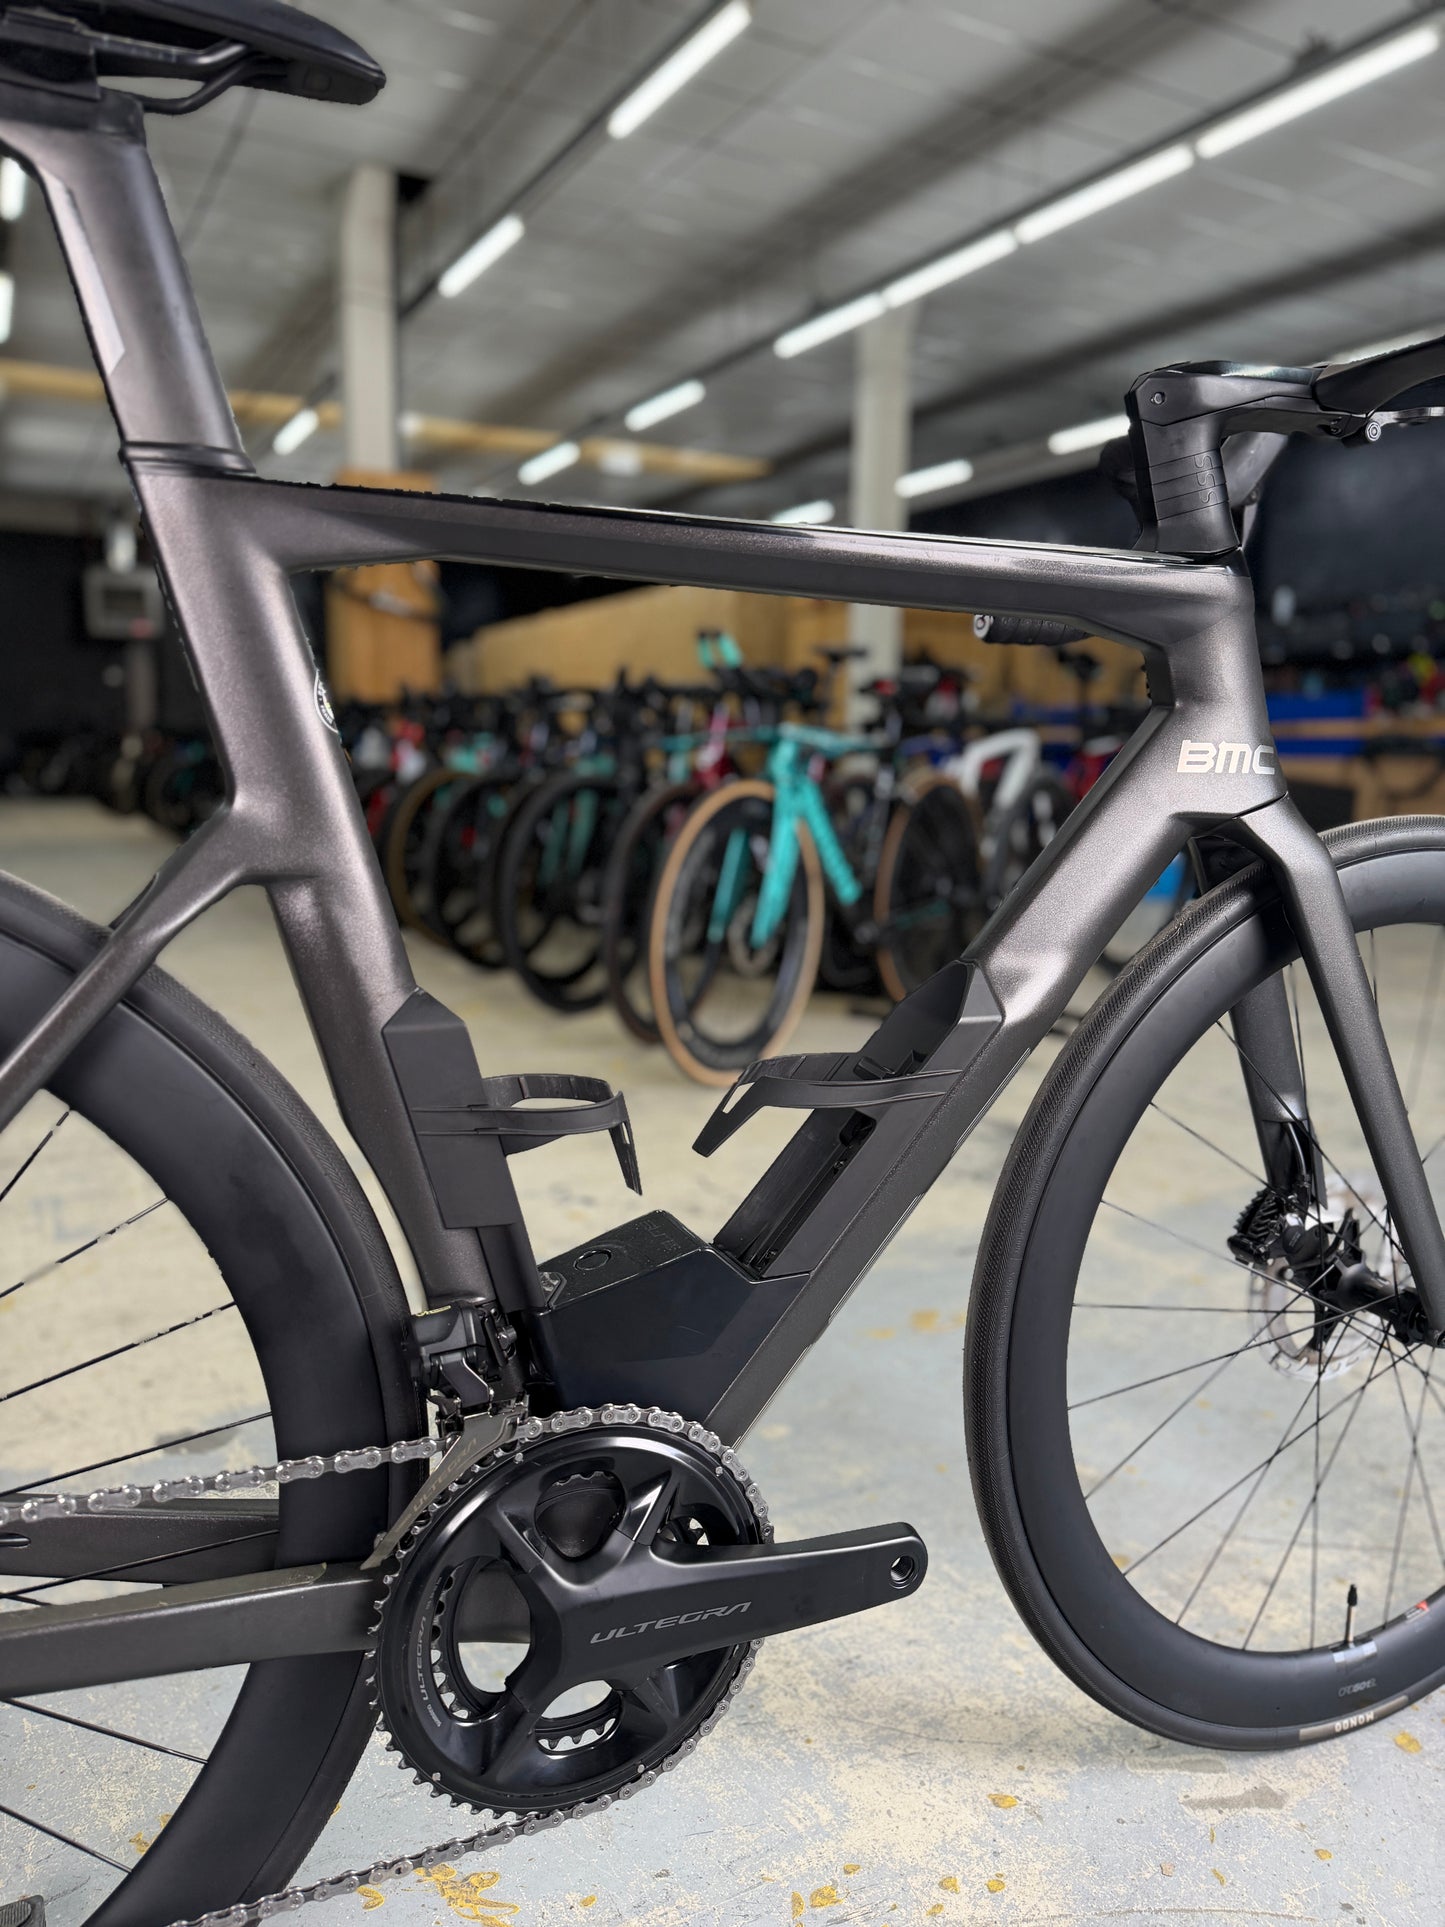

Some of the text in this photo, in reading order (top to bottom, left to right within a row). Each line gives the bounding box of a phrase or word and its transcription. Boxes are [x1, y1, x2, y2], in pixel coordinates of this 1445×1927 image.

[1177, 739, 1275, 775] BMC
[590, 1601, 752, 1644] ULTEGRA
[416, 1615, 429, 1701] ULTEGRA
